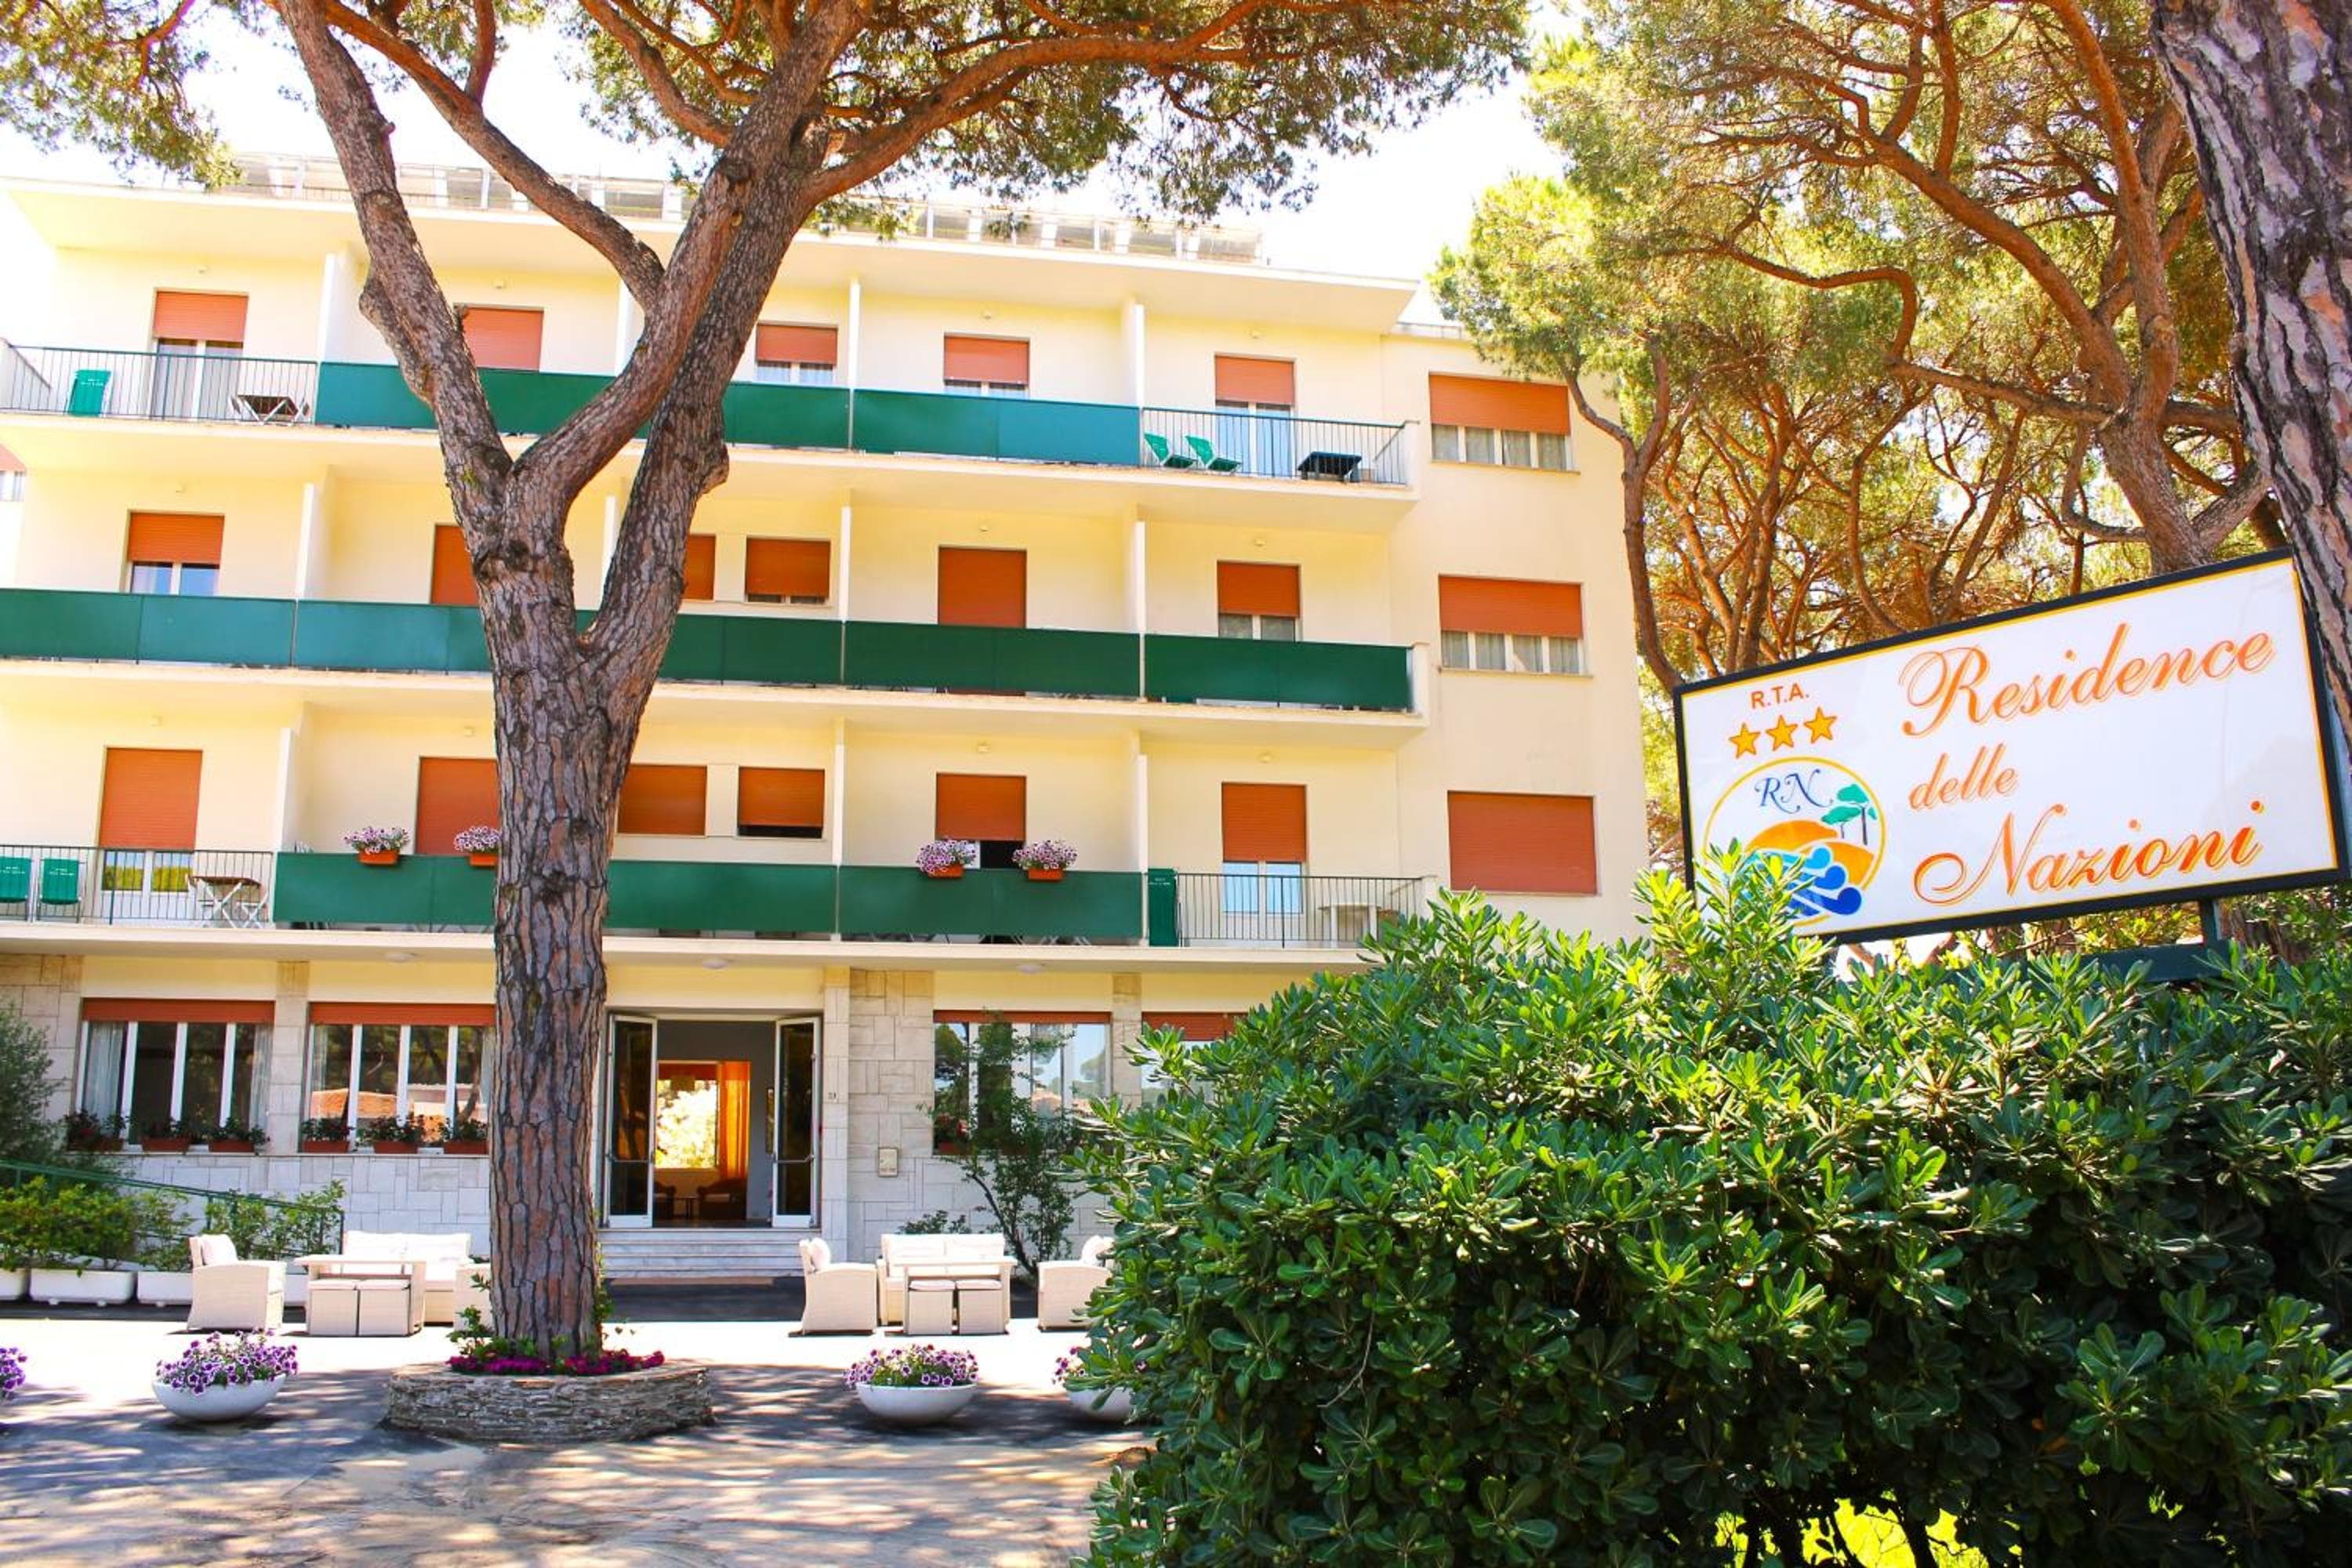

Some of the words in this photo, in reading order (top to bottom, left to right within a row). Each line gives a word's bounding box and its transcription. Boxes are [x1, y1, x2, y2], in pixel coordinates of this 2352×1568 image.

[1751, 683, 1809, 709] R.T.A.
[1898, 622, 2276, 739] Residence
[1755, 768, 1833, 815] RN
[1907, 742, 2020, 811] delle
[1911, 802, 2266, 906] Nazioni
